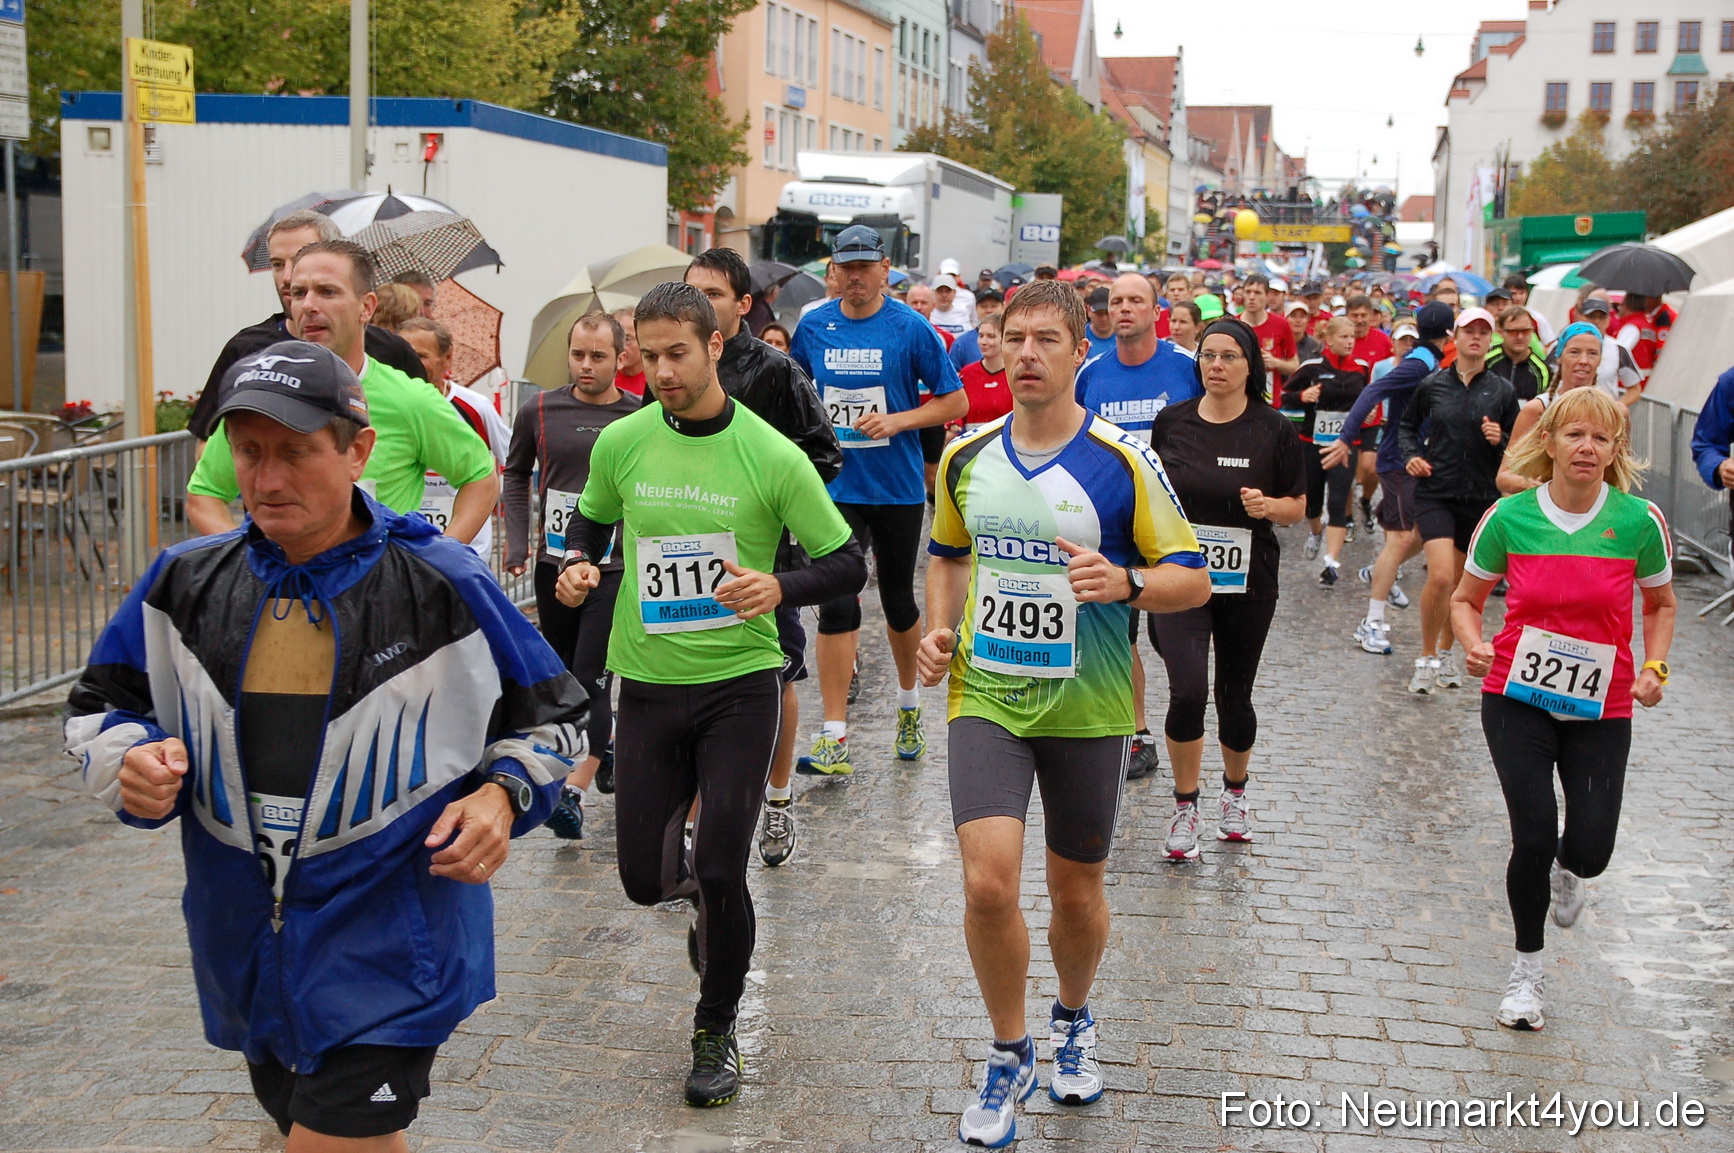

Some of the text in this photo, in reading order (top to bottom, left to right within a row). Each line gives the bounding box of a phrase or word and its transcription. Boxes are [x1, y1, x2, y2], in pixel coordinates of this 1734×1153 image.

[808, 193, 871, 208] BOCK
[1271, 227, 1312, 239] START
[824, 348, 883, 363] HUBER
[1100, 398, 1168, 417] HUBER
[1216, 456, 1251, 469] THULE
[974, 515, 1040, 536] TEAM
[1197, 529, 1228, 539] BOCK
[661, 540, 701, 553] BOCK
[976, 534, 1076, 567] BOCK
[646, 558, 727, 598] 3112
[998, 577, 1041, 592] BOCK
[659, 602, 719, 621] Matthias
[981, 594, 1064, 641] 2493
[987, 641, 1051, 667] Wolfgang
[1520, 651, 1603, 698] 3214
[1529, 691, 1577, 714] Monika
